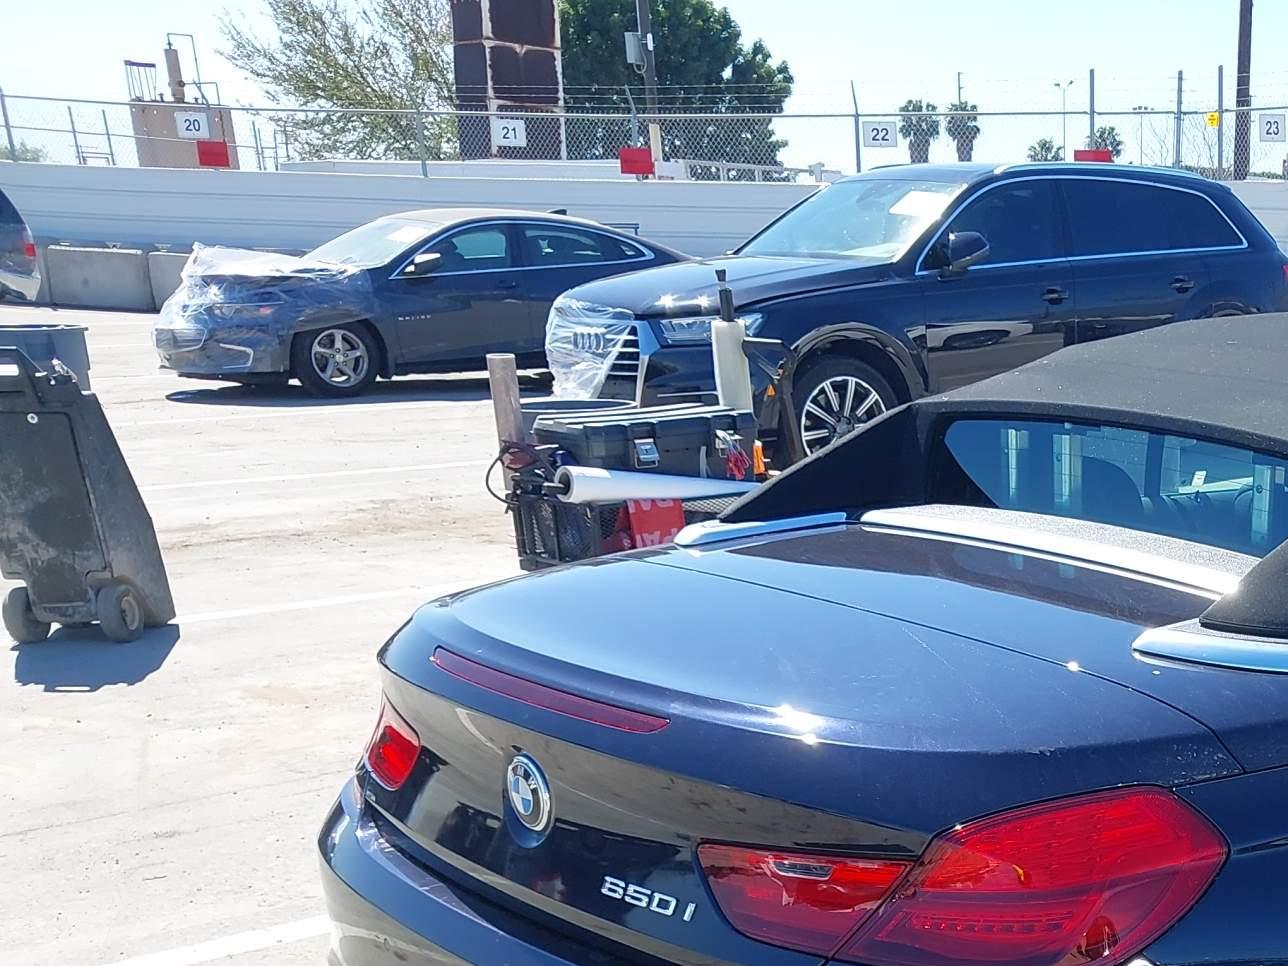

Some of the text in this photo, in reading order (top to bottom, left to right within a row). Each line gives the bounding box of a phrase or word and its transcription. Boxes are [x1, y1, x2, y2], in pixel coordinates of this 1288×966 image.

[183, 117, 202, 134] 20
[871, 126, 890, 142] 22
[1264, 119, 1280, 136] 23
[501, 126, 518, 143] 21
